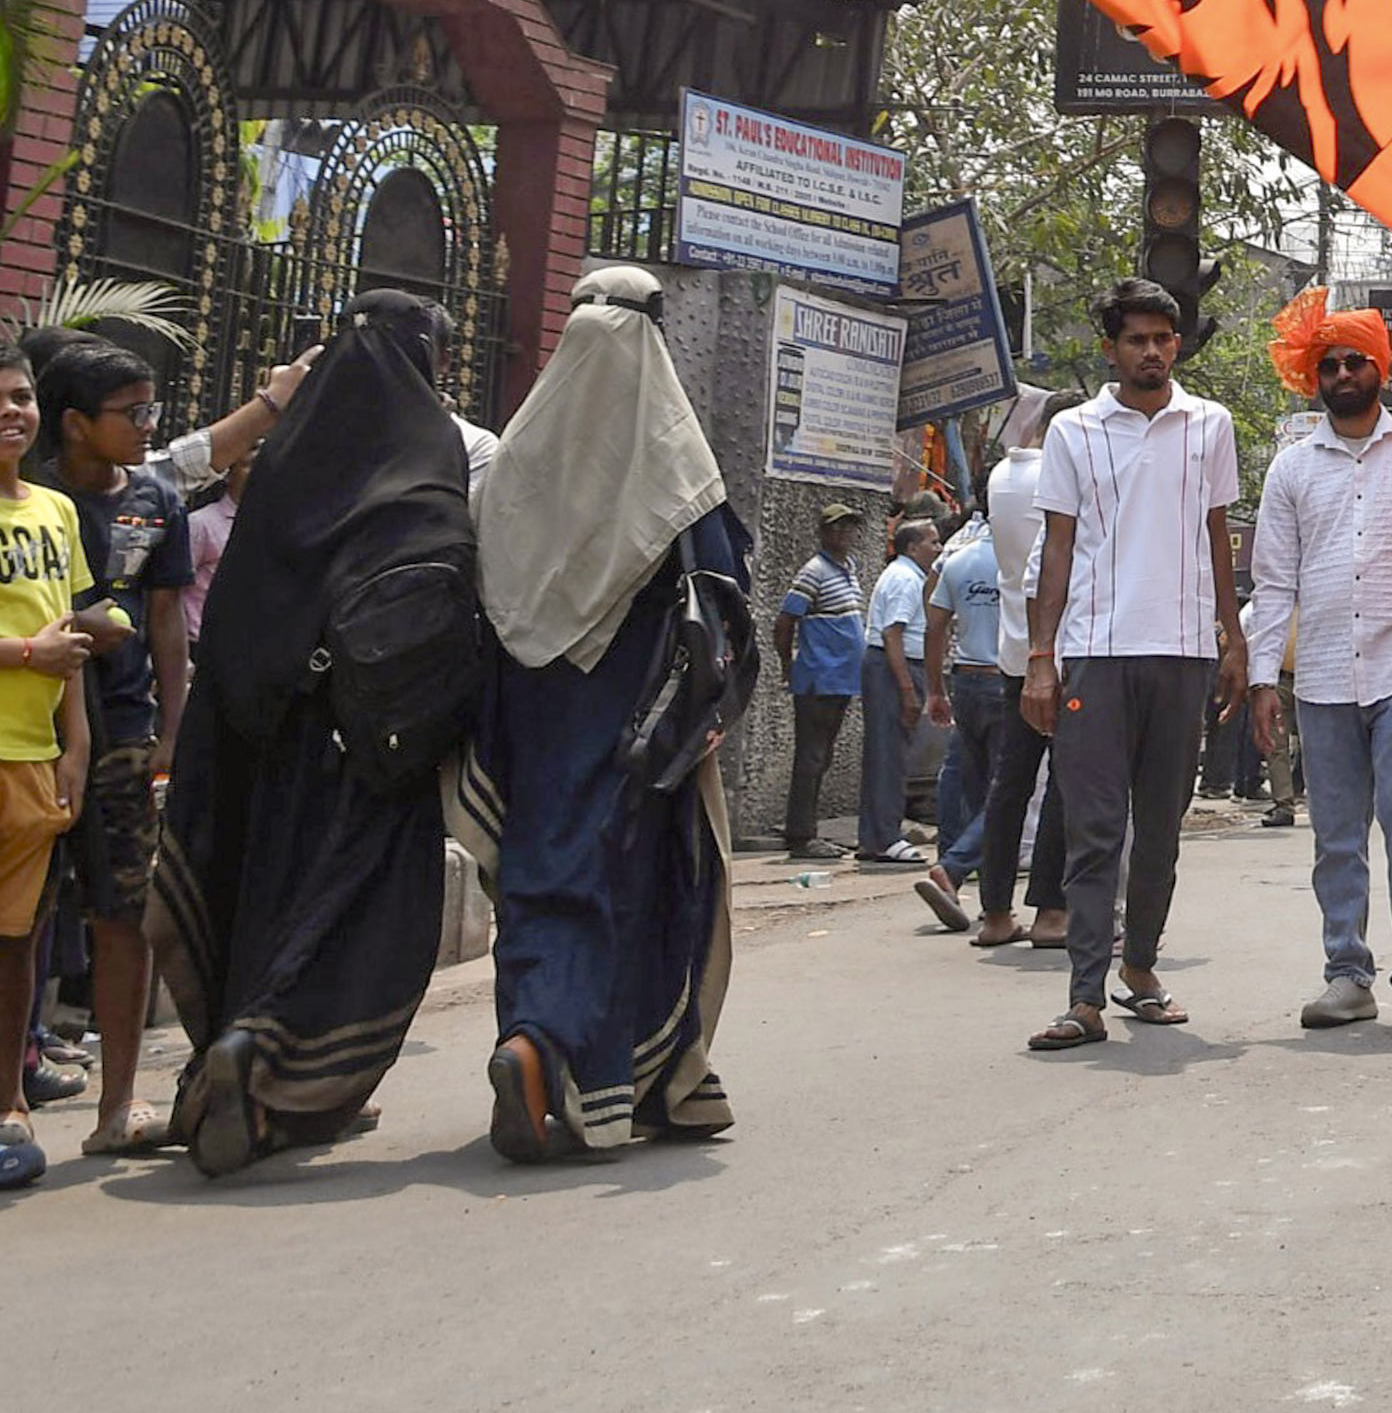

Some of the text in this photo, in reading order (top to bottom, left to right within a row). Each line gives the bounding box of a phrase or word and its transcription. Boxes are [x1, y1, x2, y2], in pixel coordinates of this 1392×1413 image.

[1078, 74, 1093, 83] 24
[1094, 74, 1137, 83] CAMAC
[716, 108, 733, 137] ST.
[774, 126, 842, 167] EDUCATIONAL
[736, 159, 796, 185] AFFILIATED
[797, 174, 811, 189] TO
[795, 305, 838, 347] SHREE
